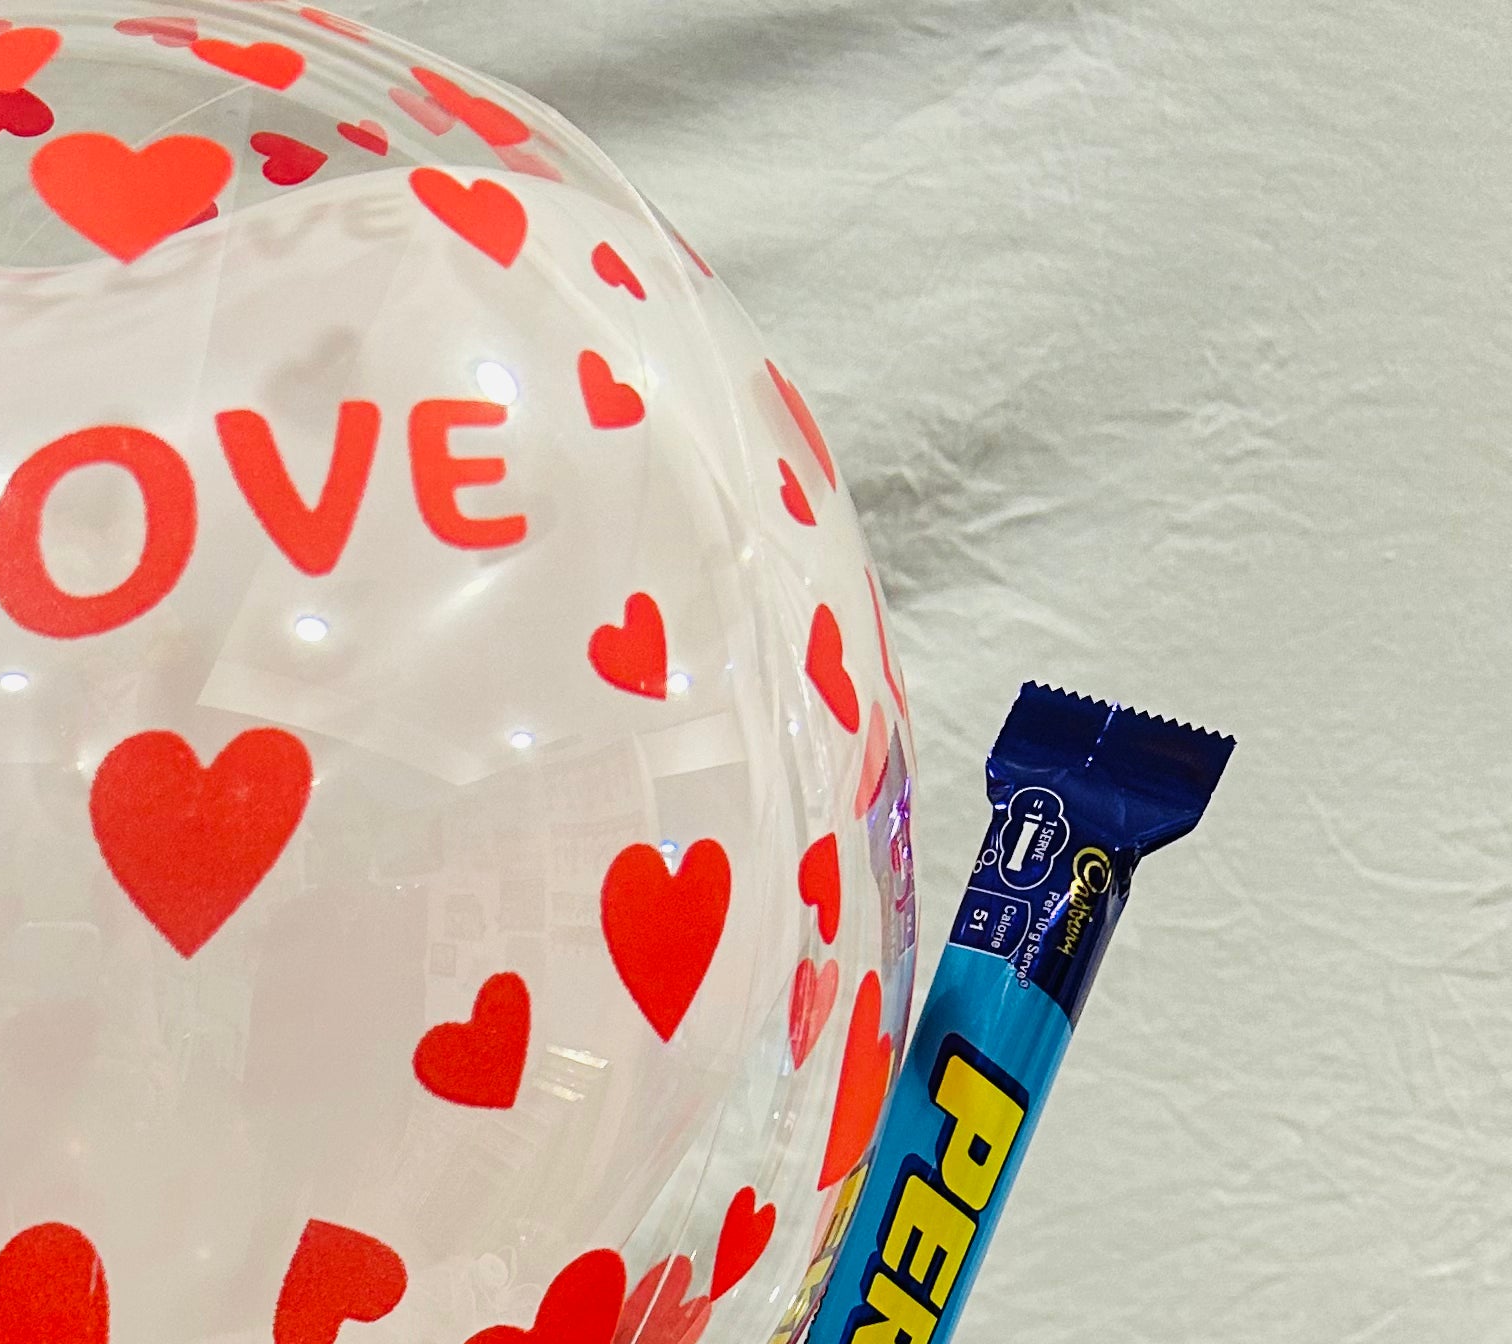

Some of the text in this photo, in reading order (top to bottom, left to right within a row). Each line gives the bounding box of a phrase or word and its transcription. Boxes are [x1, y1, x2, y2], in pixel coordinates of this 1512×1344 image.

[1031, 827, 1055, 862] SERVE
[1041, 891, 1061, 913] Per
[1056, 846, 1112, 957] Cadbury
[969, 908, 989, 932] 51
[990, 905, 1017, 950] Calorie
[1035, 916, 1050, 931] 10
